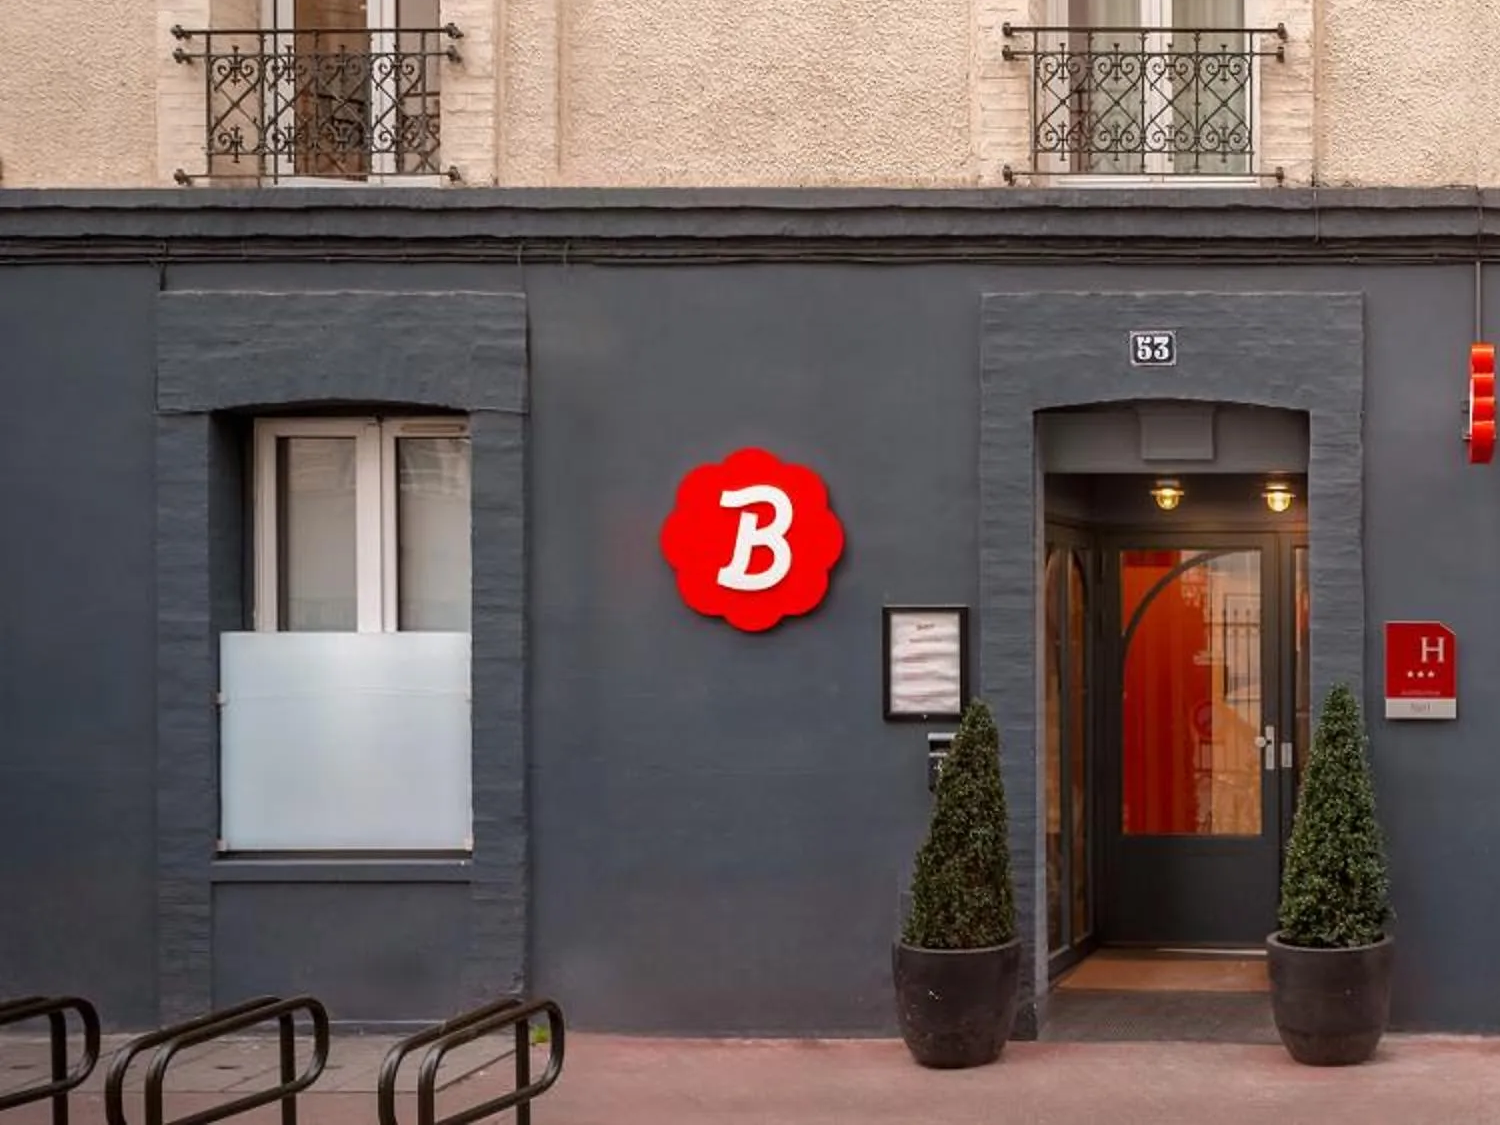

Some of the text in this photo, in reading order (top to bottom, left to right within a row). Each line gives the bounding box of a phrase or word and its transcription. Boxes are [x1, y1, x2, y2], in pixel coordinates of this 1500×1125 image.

[1136, 336, 1170, 360] 53
[716, 484, 794, 592] B
[1421, 637, 1445, 664] H
